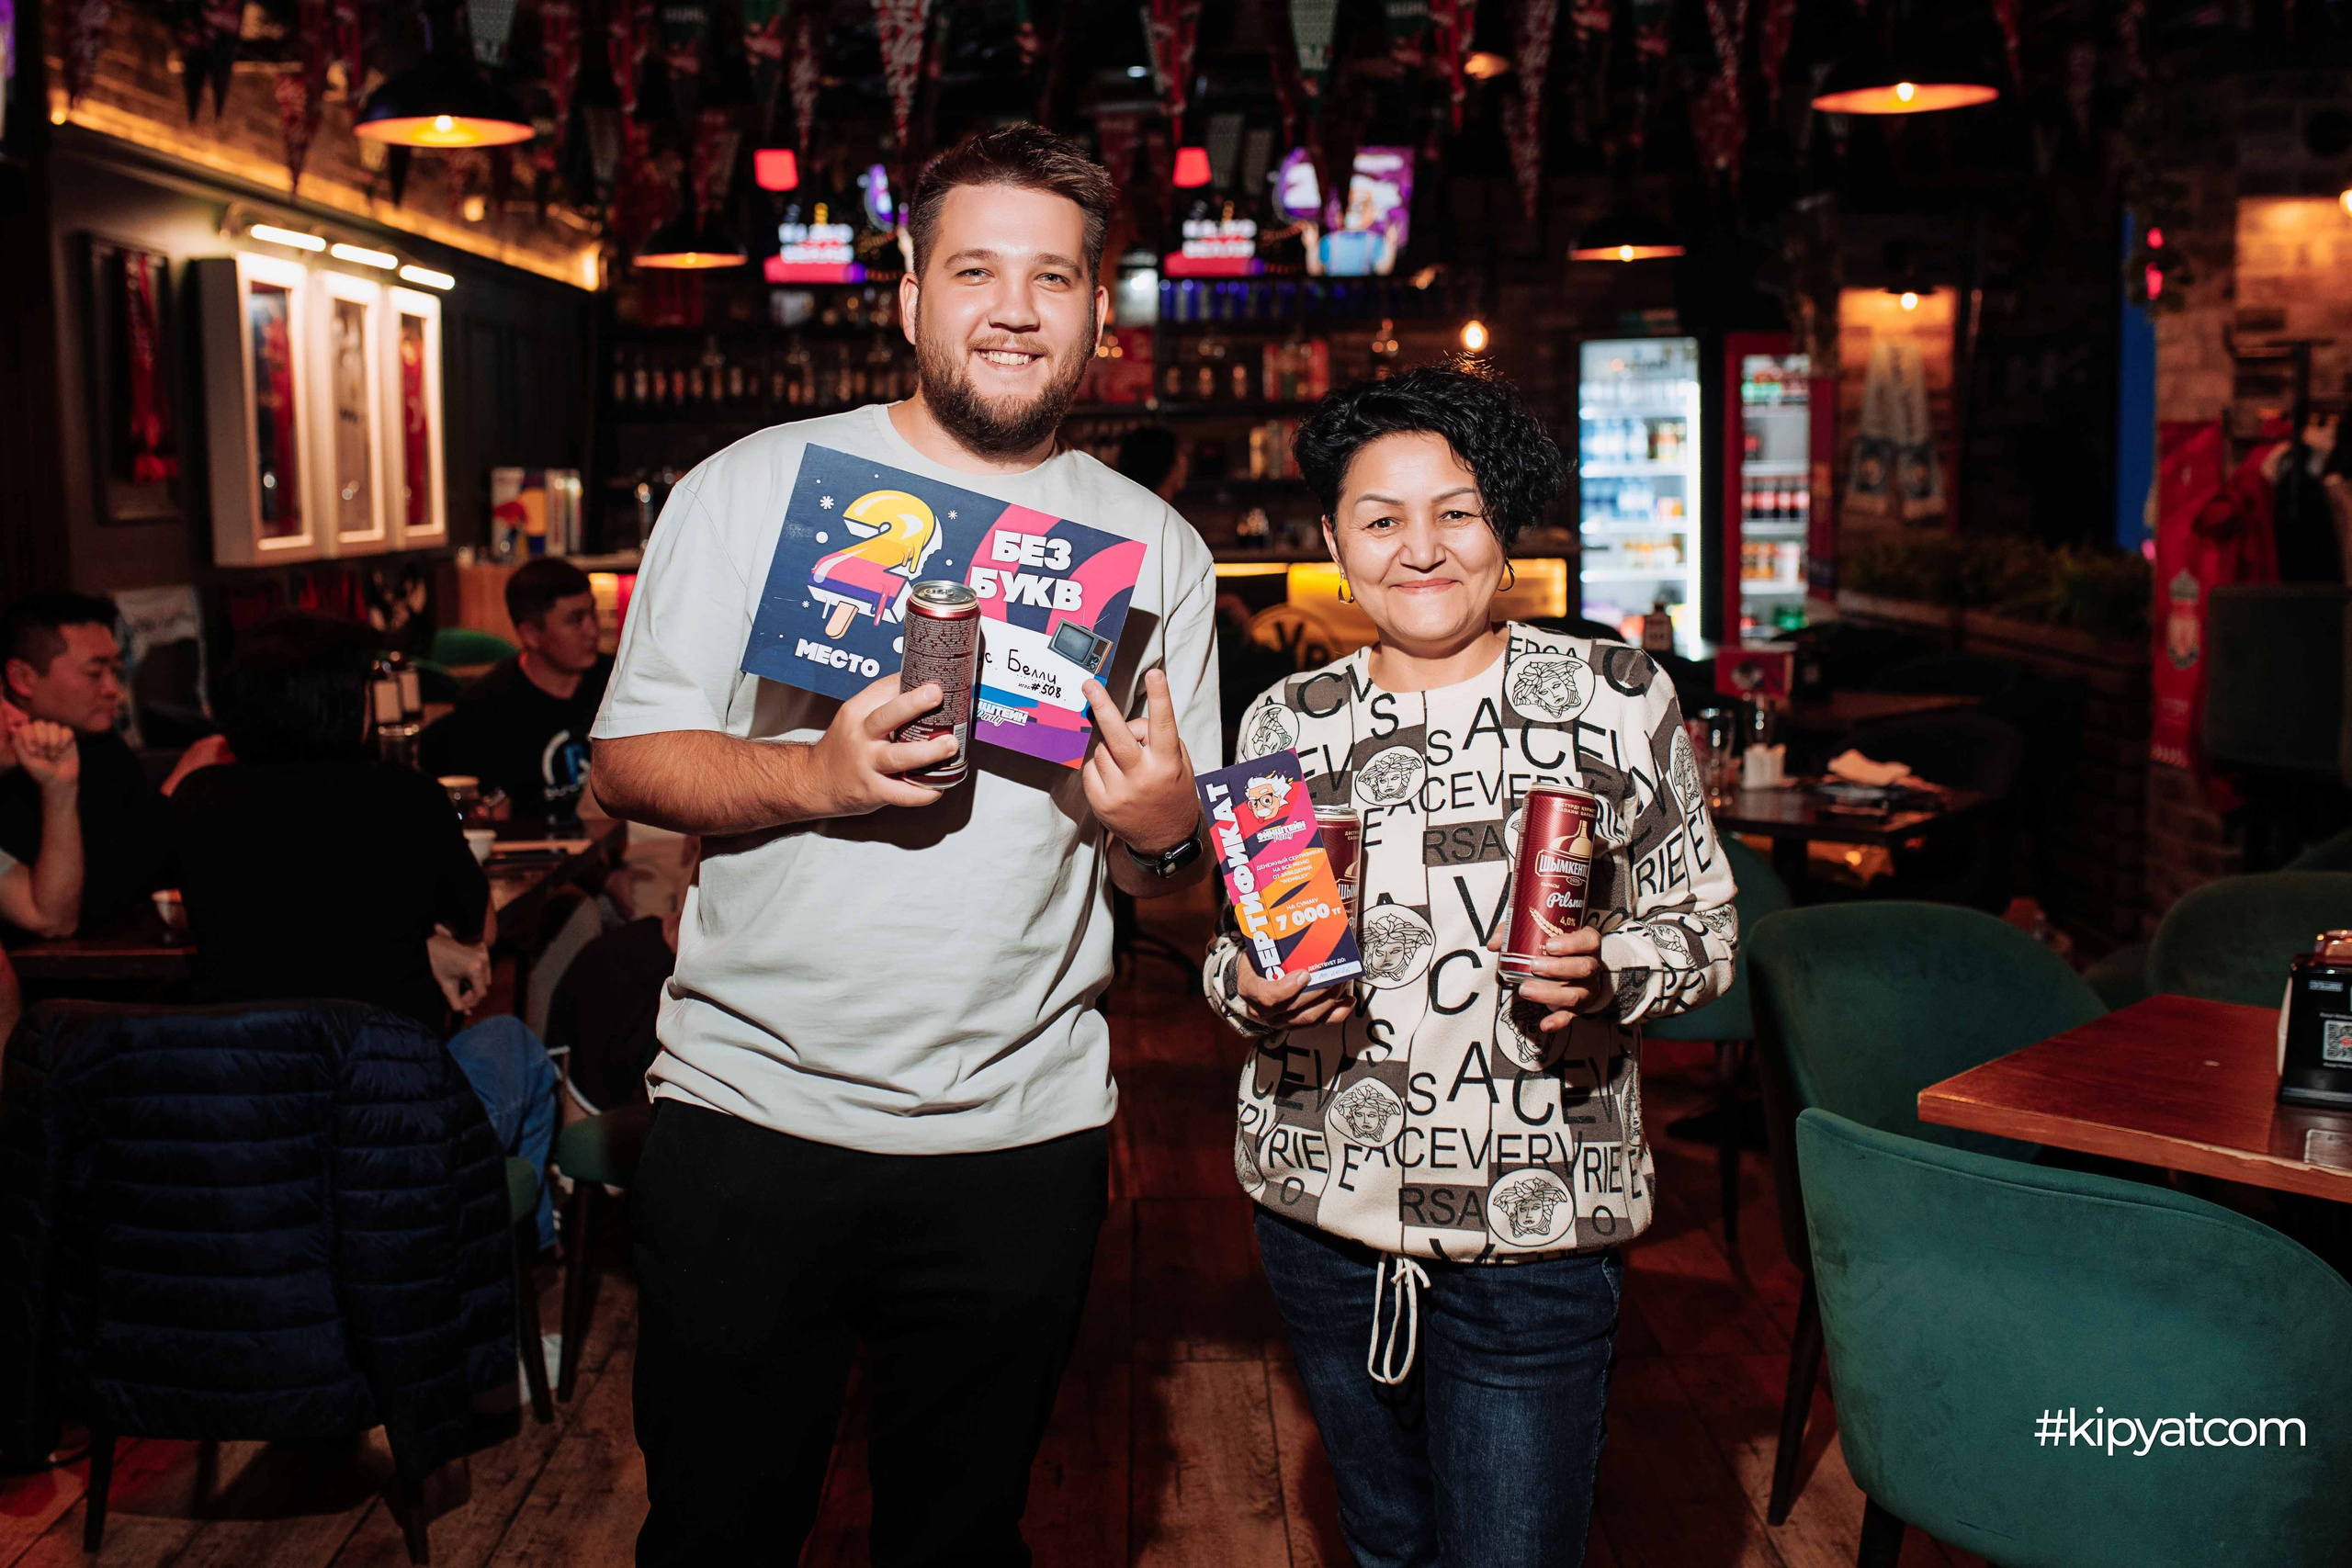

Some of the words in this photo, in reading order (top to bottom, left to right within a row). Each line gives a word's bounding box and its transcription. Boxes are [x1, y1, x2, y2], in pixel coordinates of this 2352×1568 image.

[992, 530, 1072, 571] БЕЗ
[969, 567, 1083, 613] БУКВ
[795, 638, 880, 678] МЕСТО
[1030, 682, 1062, 699] #508
[1205, 783, 1286, 982] СЕРТИФИКАТ
[1296, 897, 1319, 908] СУММУ
